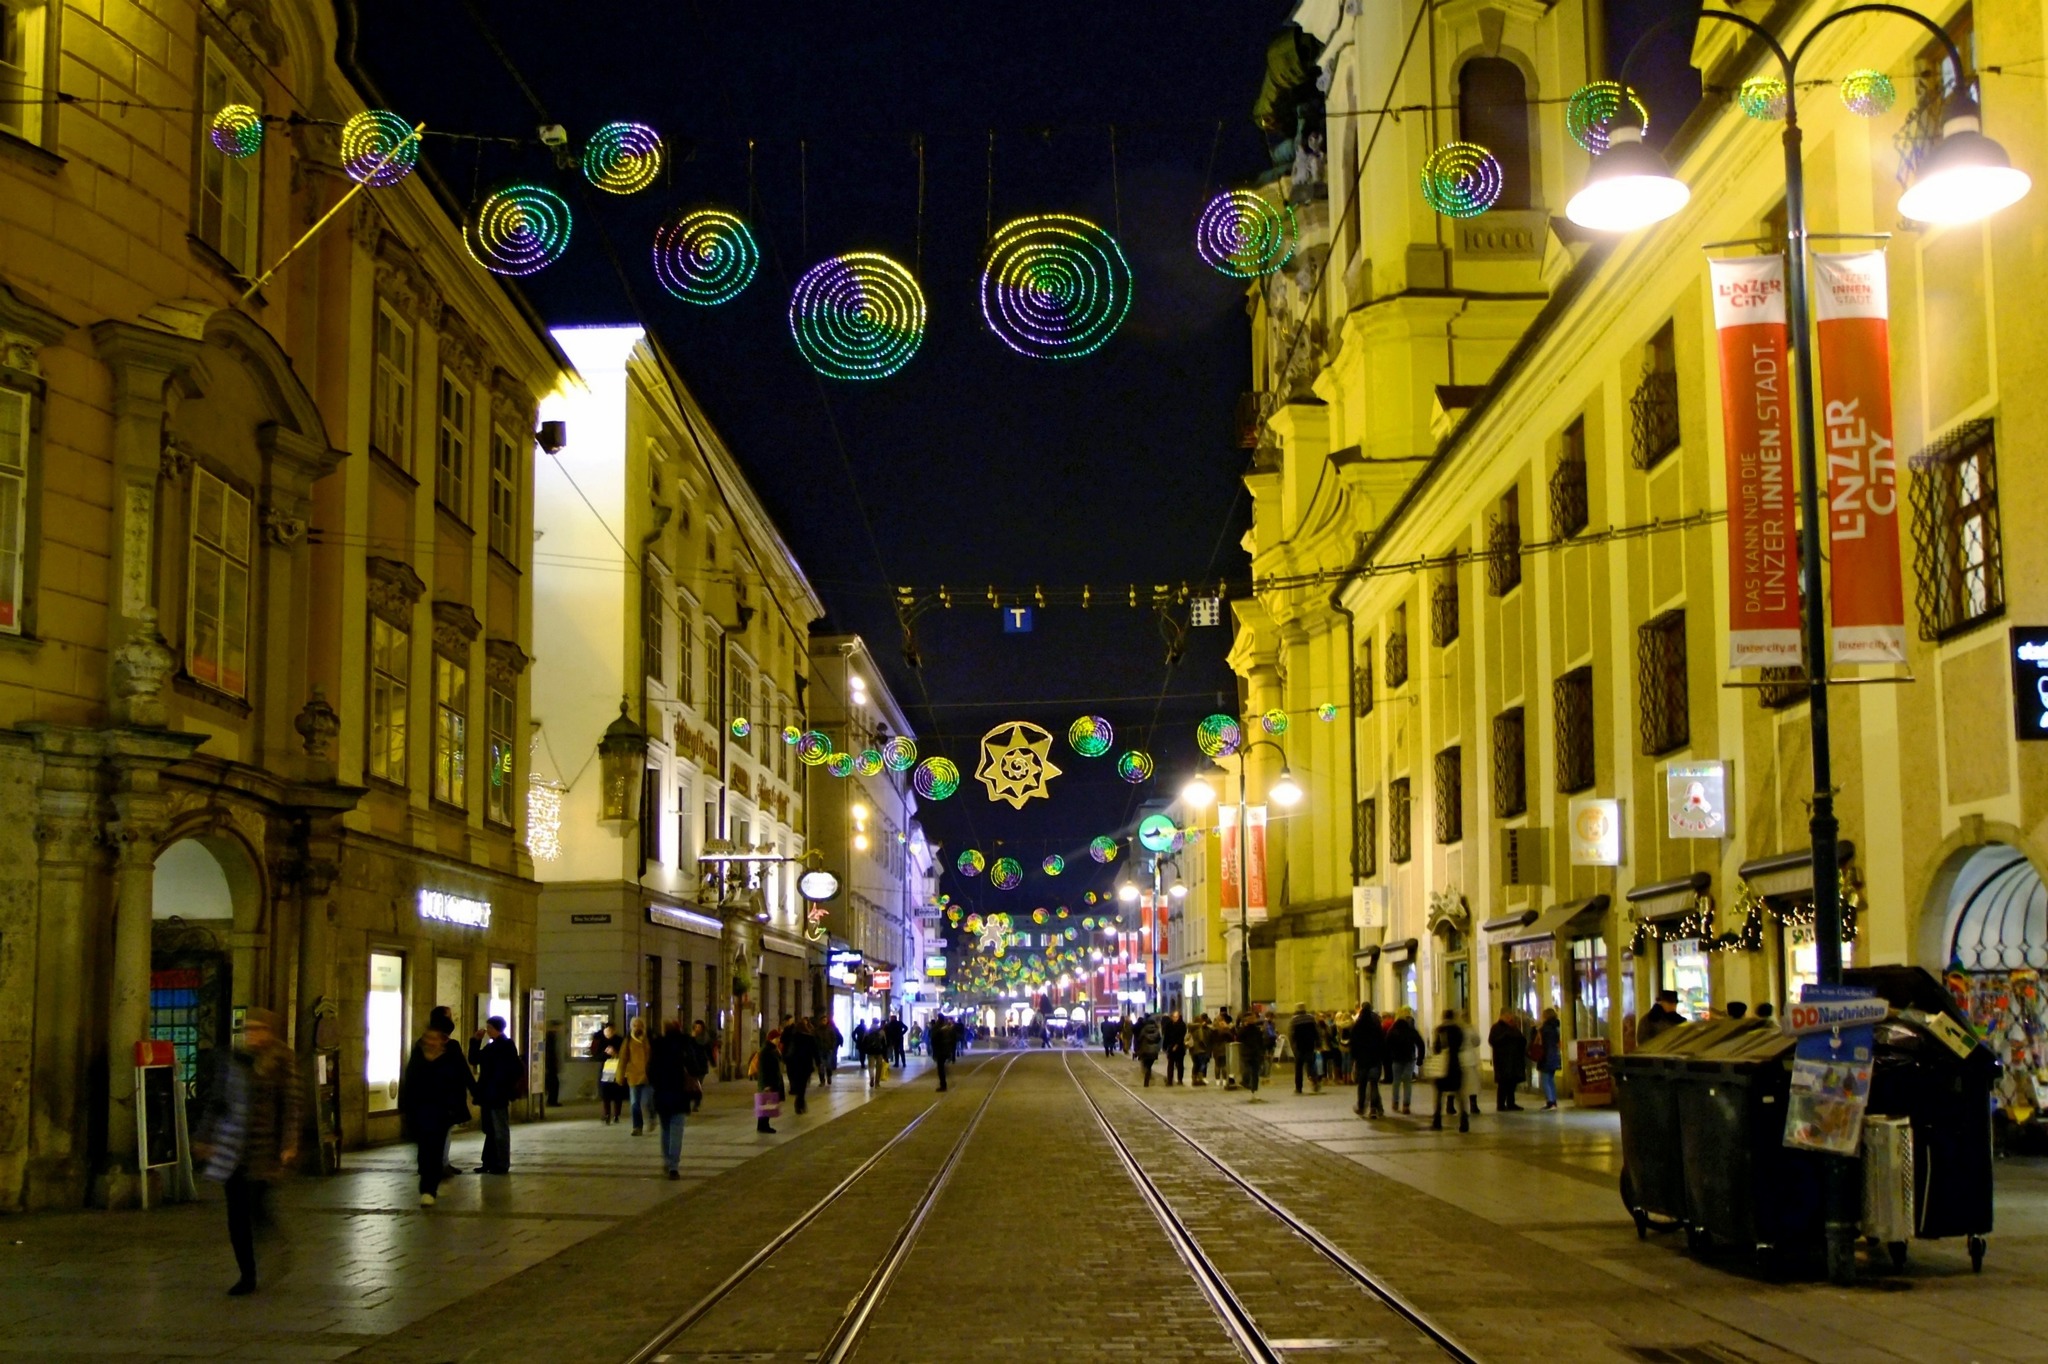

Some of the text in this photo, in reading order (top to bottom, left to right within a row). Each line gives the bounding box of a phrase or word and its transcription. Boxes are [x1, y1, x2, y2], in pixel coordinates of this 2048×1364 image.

[1740, 452, 1760, 613] DAS KANN NUR DIE
[1010, 608, 1026, 628] T
